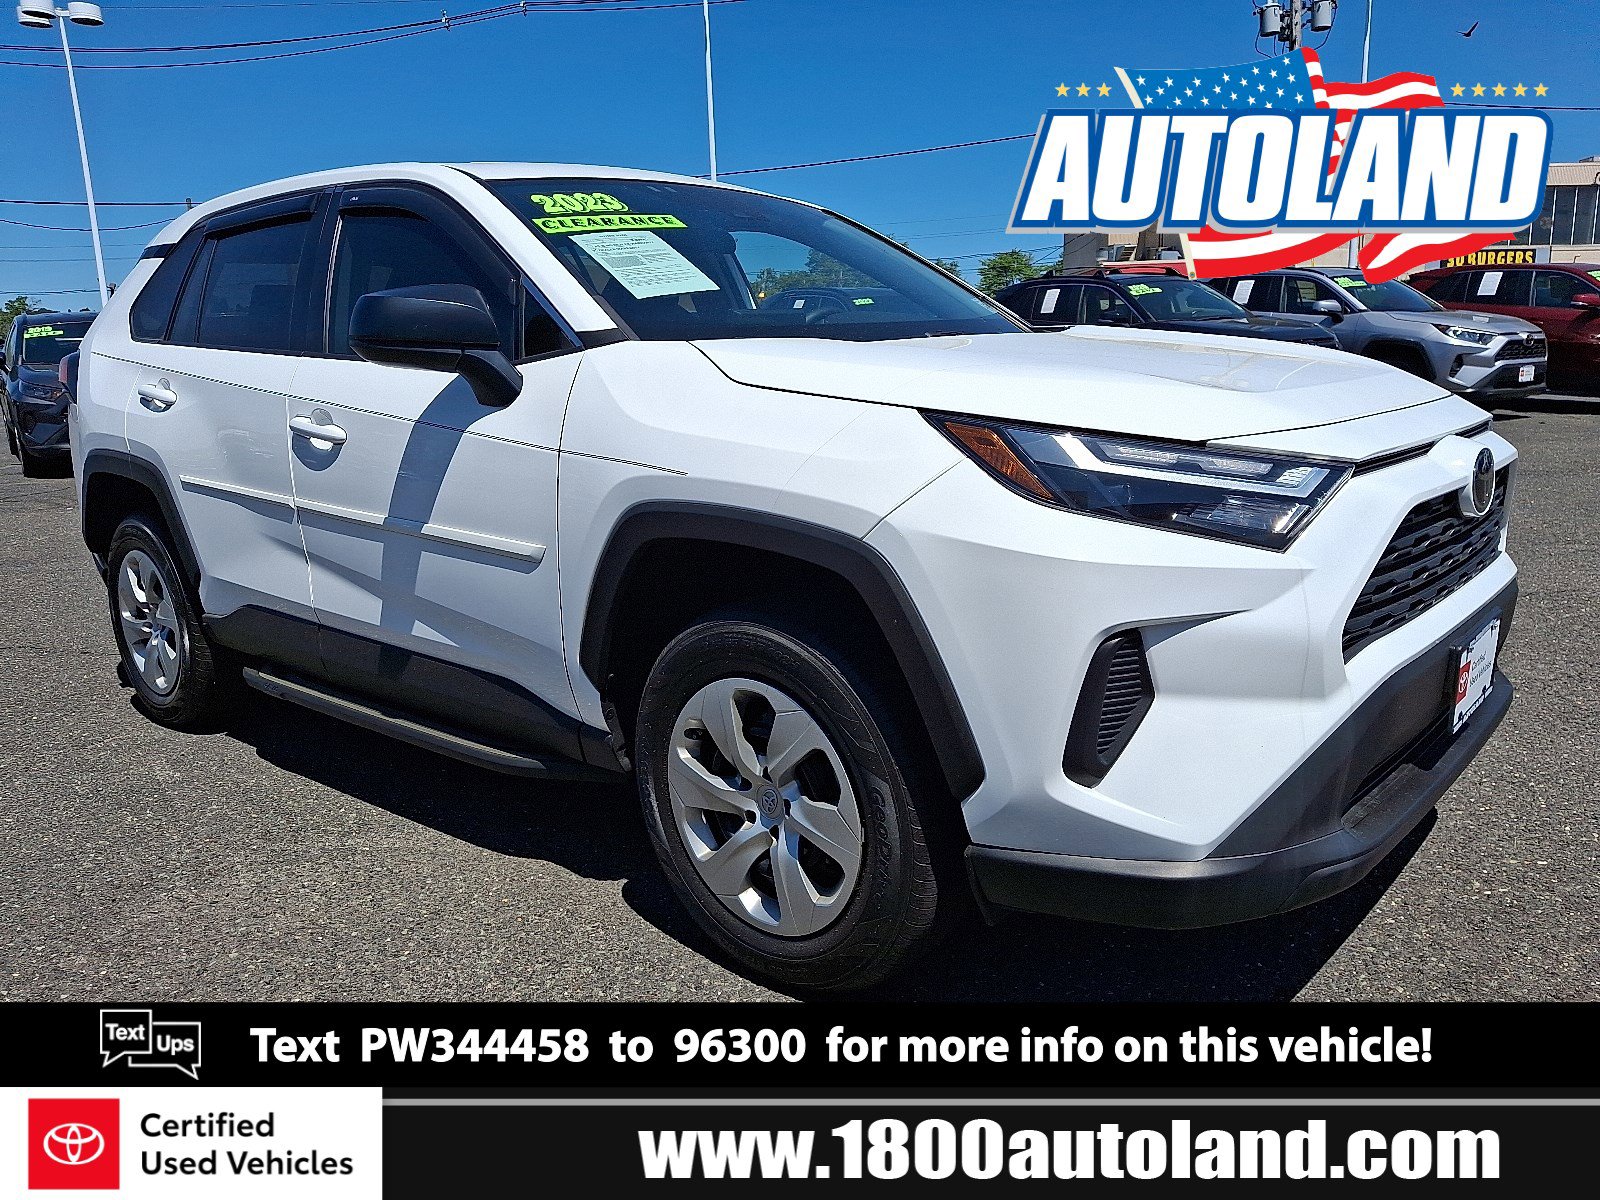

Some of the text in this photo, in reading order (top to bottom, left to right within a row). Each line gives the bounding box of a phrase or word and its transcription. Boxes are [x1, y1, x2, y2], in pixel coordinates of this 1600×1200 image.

[531, 192, 628, 214] 2023
[541, 216, 677, 229] CLEARANCE
[1467, 251, 1533, 265] BURGERS
